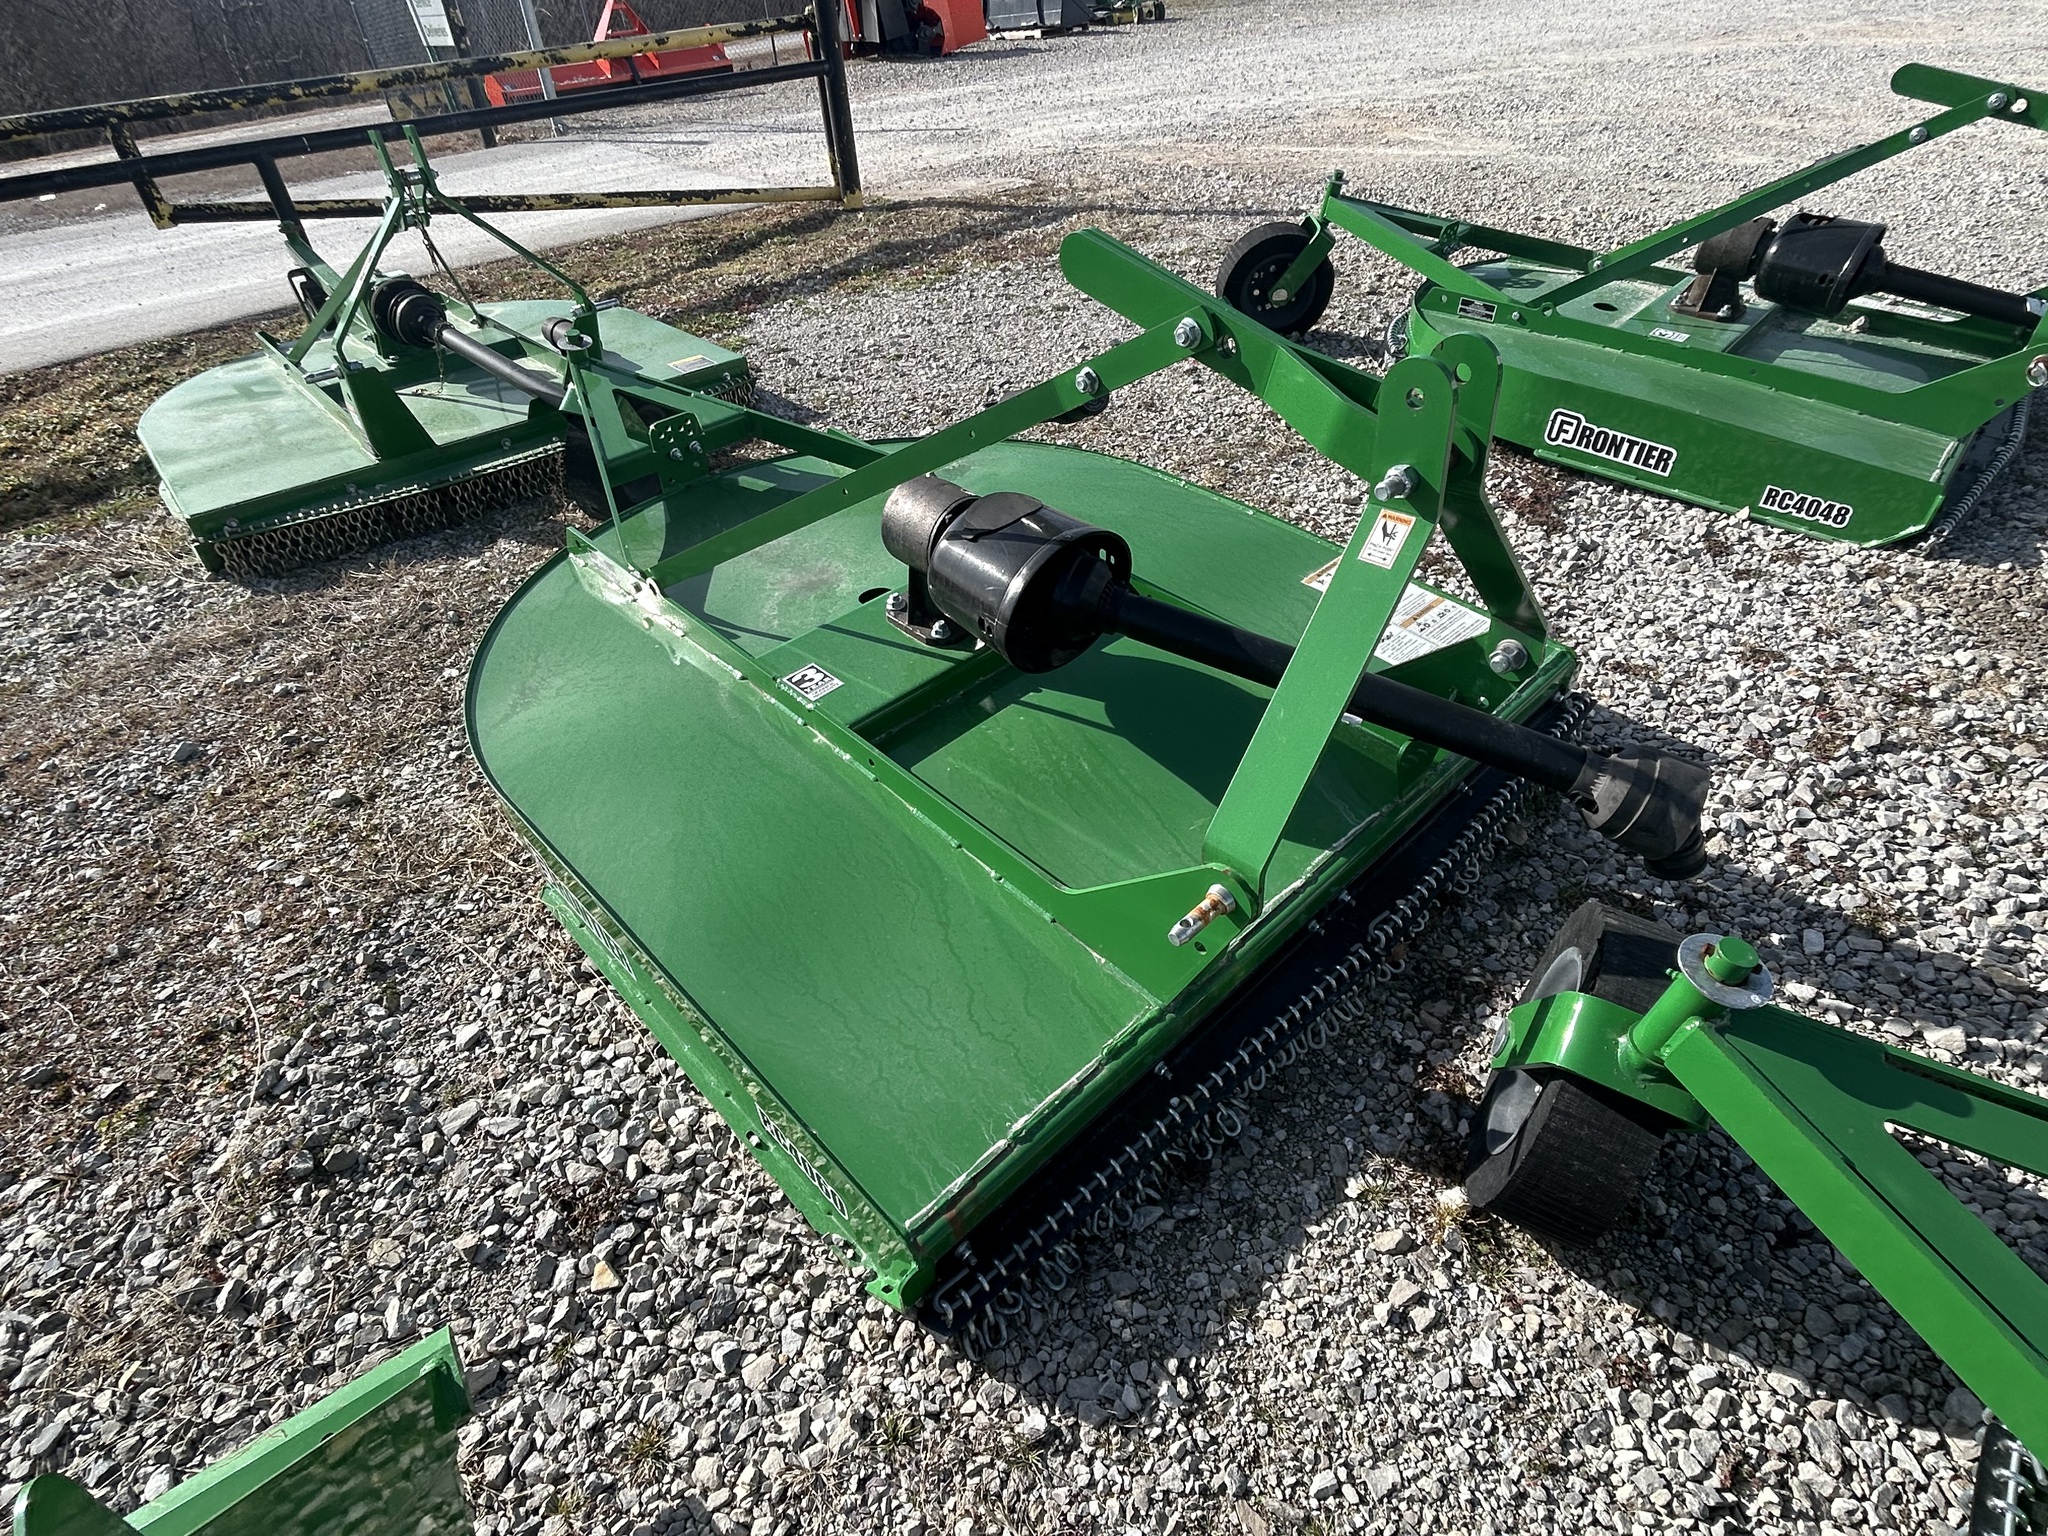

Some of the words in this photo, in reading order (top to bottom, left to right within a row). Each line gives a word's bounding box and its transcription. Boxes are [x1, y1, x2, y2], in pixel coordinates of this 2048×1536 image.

[1546, 410, 1674, 474] FRONTIER
[1762, 486, 1851, 526] RC4048
[791, 668, 825, 689] 3
[757, 1104, 848, 1219] RC4060
